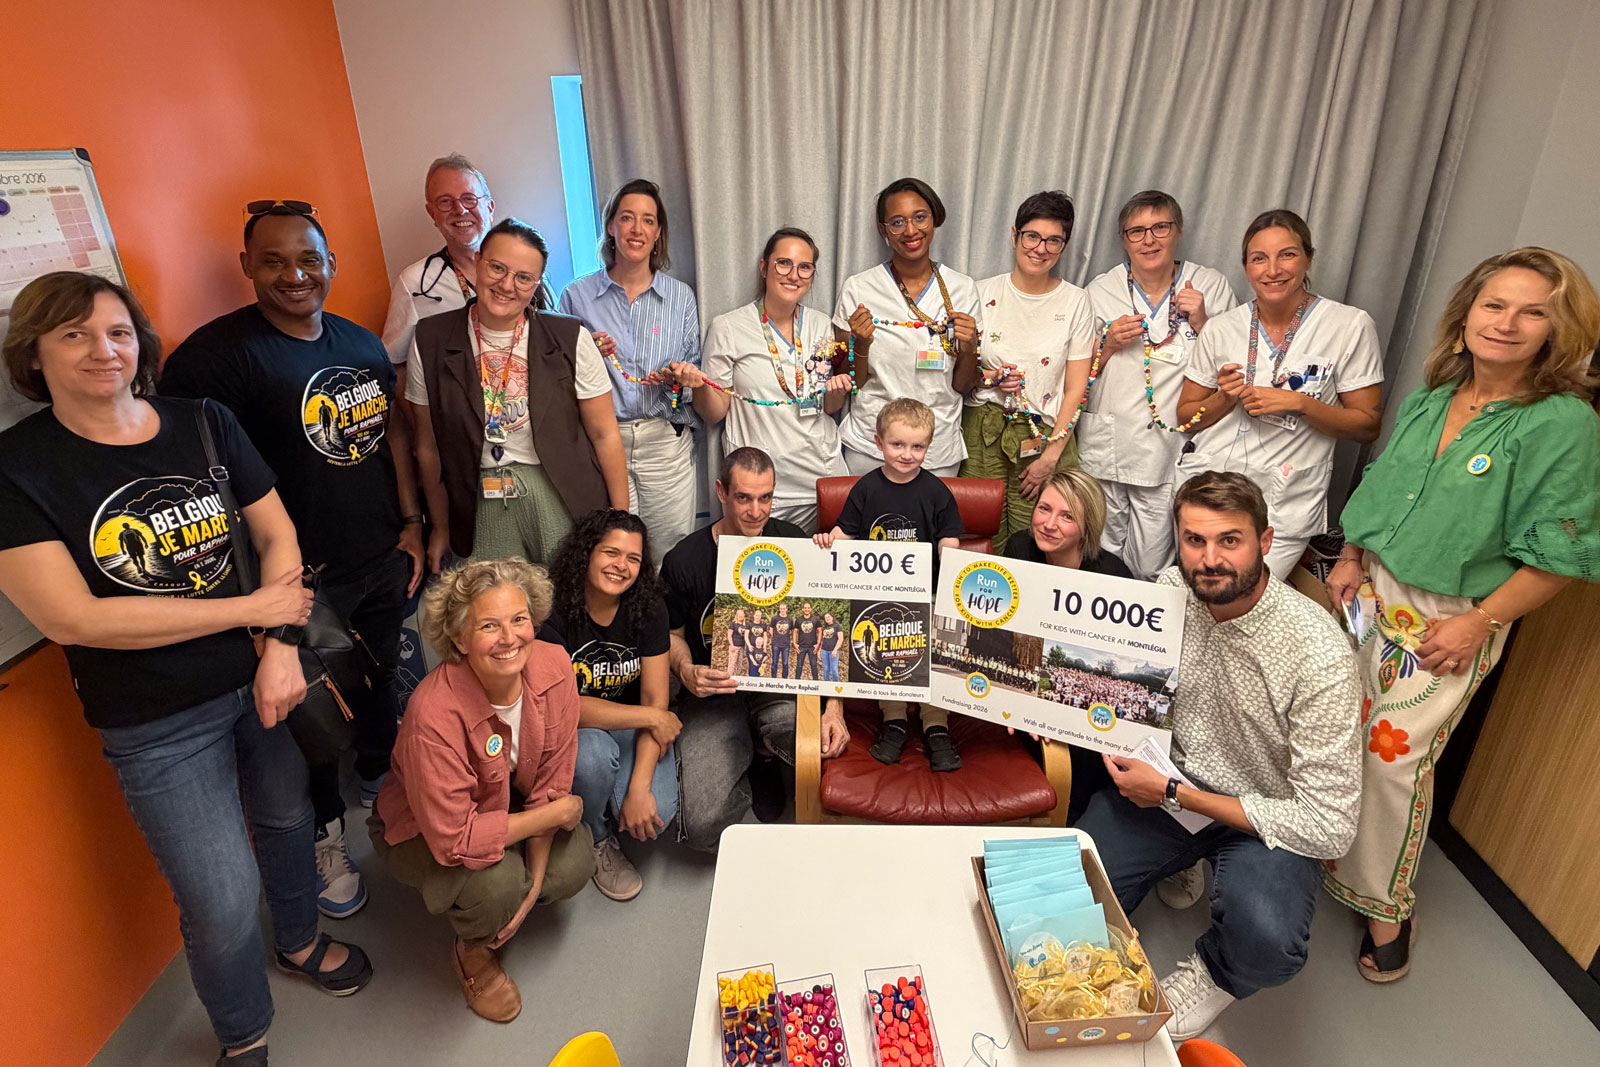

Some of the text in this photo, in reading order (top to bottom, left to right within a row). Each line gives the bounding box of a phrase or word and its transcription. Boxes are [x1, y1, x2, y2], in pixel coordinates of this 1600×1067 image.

[0, 172, 47, 185] bre 2026
[335, 380, 383, 411] BELGIQUE
[338, 394, 388, 429] JE MARCHE
[150, 494, 225, 535] BELGIQU
[159, 513, 229, 556] JE MARC
[887, 528, 917, 539] BELGIQUE
[173, 547, 197, 564] POUR
[754, 556, 774, 567] Run
[770, 545, 782, 554] LIFE
[782, 554, 793, 574] BETTER
[830, 551, 915, 575] 1 300 €
[742, 591, 754, 602] KIDS
[774, 580, 792, 600] CANCER
[747, 574, 781, 593] HOPE
[955, 576, 964, 588] RUN
[994, 565, 1008, 575] LIFE
[1008, 576, 1018, 600] BETTER
[977, 574, 998, 588] Run
[967, 592, 1004, 614] HOPE
[1053, 588, 1082, 616] 10
[961, 608, 974, 622] KIDS
[995, 606, 1016, 626] CANCER
[880, 620, 923, 638] BELGIQUE
[1040, 622, 1052, 630] FOR
[1070, 628, 1086, 636] WITH
[1088, 632, 1116, 644] CANCER
[1127, 640, 1166, 654] MONTLÉGIA
[877, 634, 926, 651] JE MARCHE
[942, 696, 988, 713] Fundraising 2026
[1024, 718, 1037, 726] With
[1058, 728, 1084, 739] gratitude
[1104, 741, 1121, 751] many
